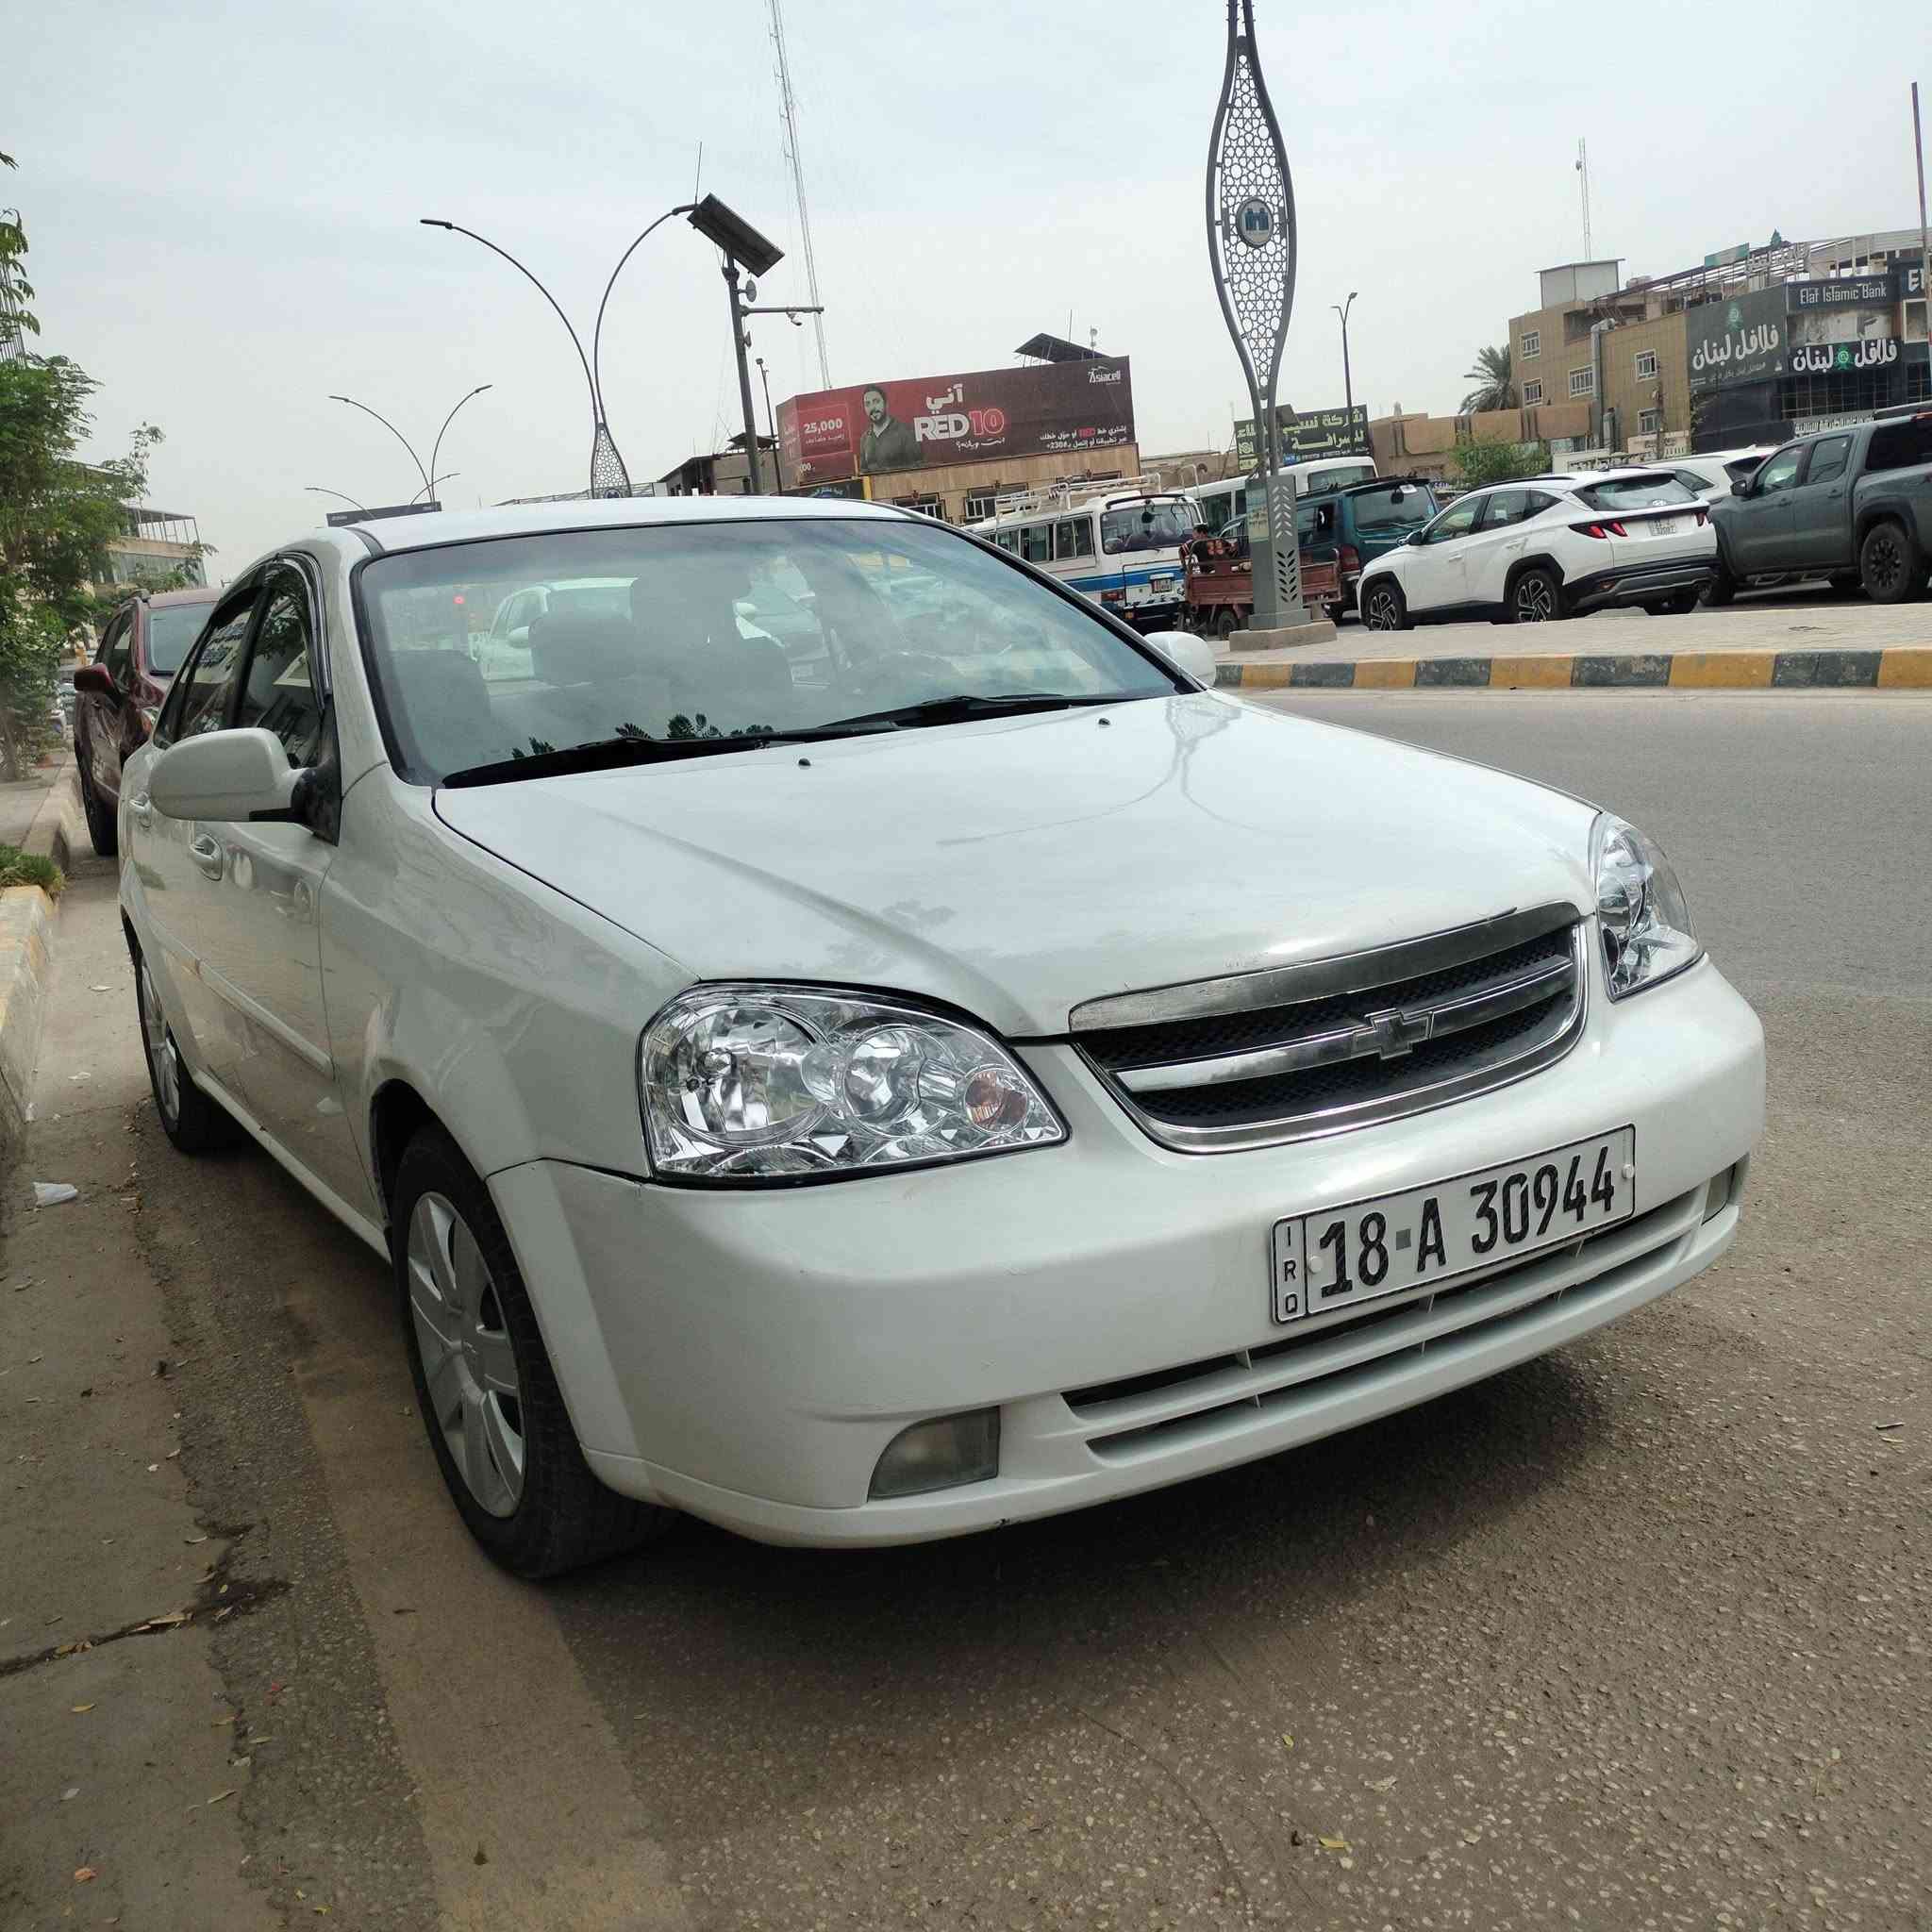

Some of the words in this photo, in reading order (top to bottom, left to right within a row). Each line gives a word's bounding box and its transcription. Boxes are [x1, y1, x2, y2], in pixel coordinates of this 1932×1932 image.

[1800, 288, 1819, 305] Elaf
[1823, 286, 1858, 303] Islamic
[1862, 282, 1887, 299] Bank
[1692, 334, 1732, 371] لبنان
[1792, 344, 1834, 373] لبنان
[925, 383, 963, 414] آني
[804, 418, 842, 434] 25,000
[1319, 1212, 1390, 1299] 18
[1417, 1196, 1447, 1273] A
[1470, 1145, 1615, 1254] 30944
